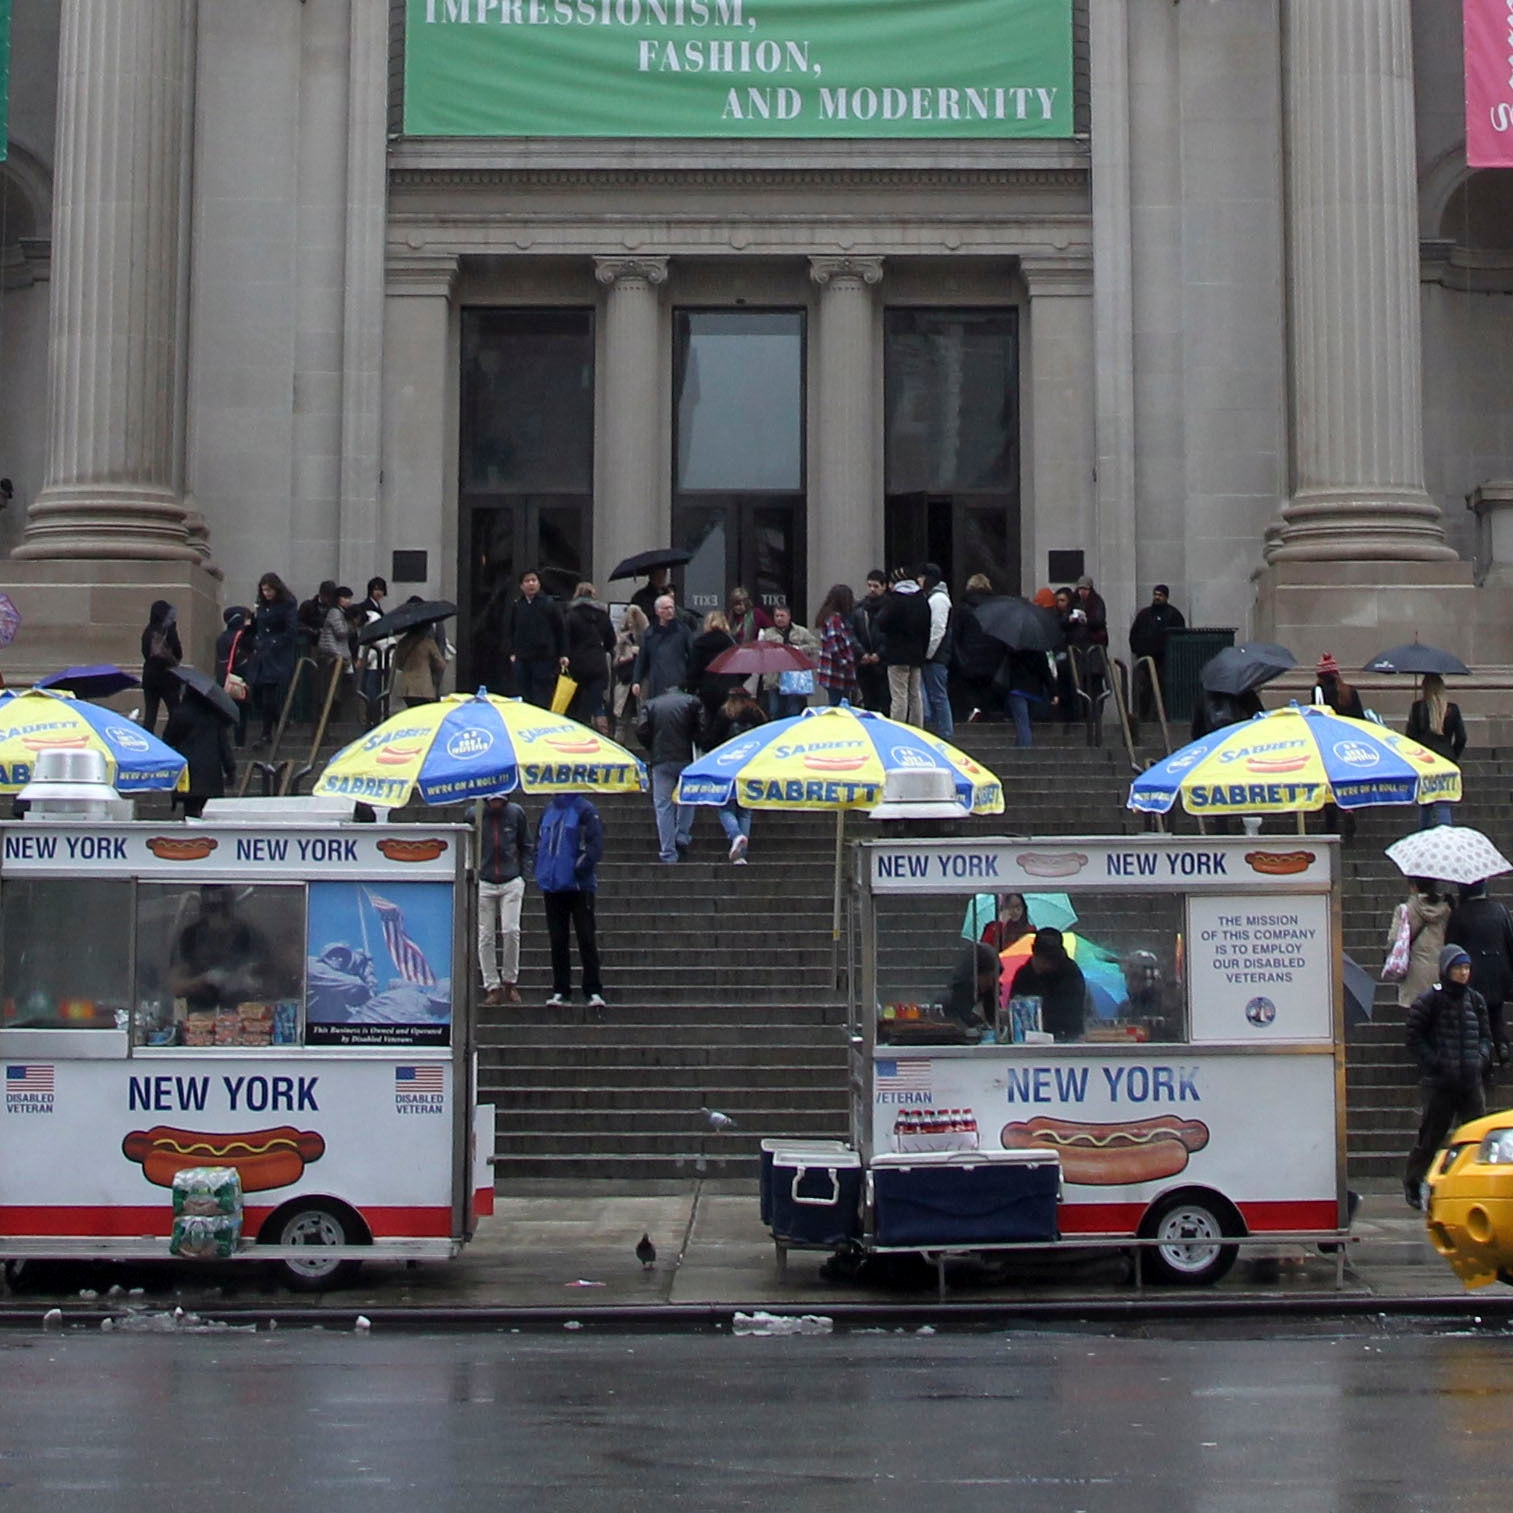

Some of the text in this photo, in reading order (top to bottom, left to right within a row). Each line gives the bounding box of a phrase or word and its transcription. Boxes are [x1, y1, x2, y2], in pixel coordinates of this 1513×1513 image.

[637, 40, 822, 78] FASHION,
[721, 86, 1058, 121] AND MODERNITY
[1219, 739, 1306, 763] SABRETT
[525, 763, 631, 785] SABRETT
[322, 775, 410, 800] SABRETT
[746, 779, 881, 802] SABRETT
[1191, 783, 1320, 807] SABRETT
[5, 837, 127, 860] NEW YORK
[237, 838, 358, 861] NEW YORK
[877, 853, 999, 878] NEW YORK
[1107, 851, 1228, 876] NEW YORK
[1218, 915, 1299, 927] THE MISSION
[1201, 929, 1317, 941] OF THIS COMPANY
[1215, 943, 1303, 955] IS TO EMPLOY
[1213, 957, 1306, 969] OUR DISABLED
[1226, 972, 1293, 984] VETERANS
[128, 1075, 320, 1112] NEW YORK
[1006, 1066, 1201, 1103] NEW YORK
[6, 1093, 55, 1103] DISABLED
[7, 1103, 54, 1113] VETERAN
[395, 1094, 444, 1104] DISABLED
[396, 1104, 442, 1114] VETERAN
